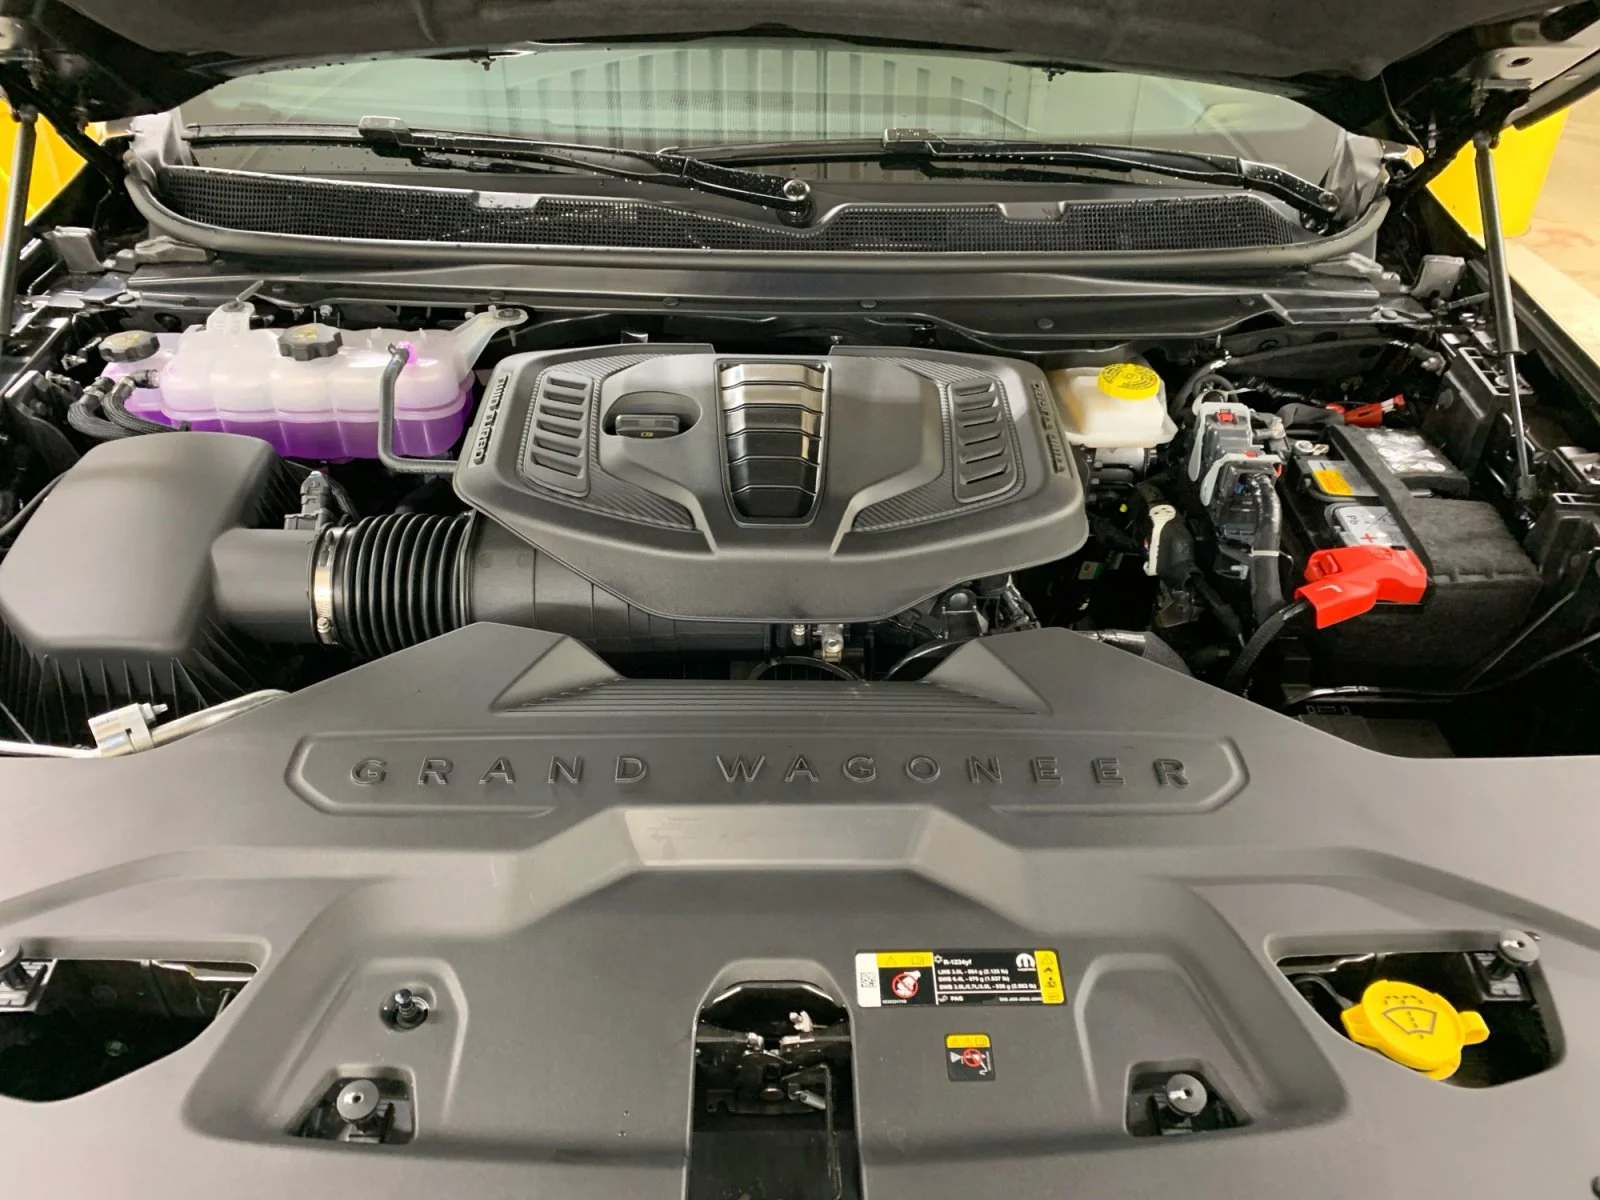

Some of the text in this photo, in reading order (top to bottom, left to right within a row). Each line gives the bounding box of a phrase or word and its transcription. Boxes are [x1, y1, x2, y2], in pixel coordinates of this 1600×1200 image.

[473, 375, 509, 465] TWIN TURBO
[1031, 381, 1052, 430] TURBO
[1346, 515, 1360, 525] Pb
[350, 754, 1191, 787] GRAND WAGONEER
[943, 958, 972, 967] R-1234yf
